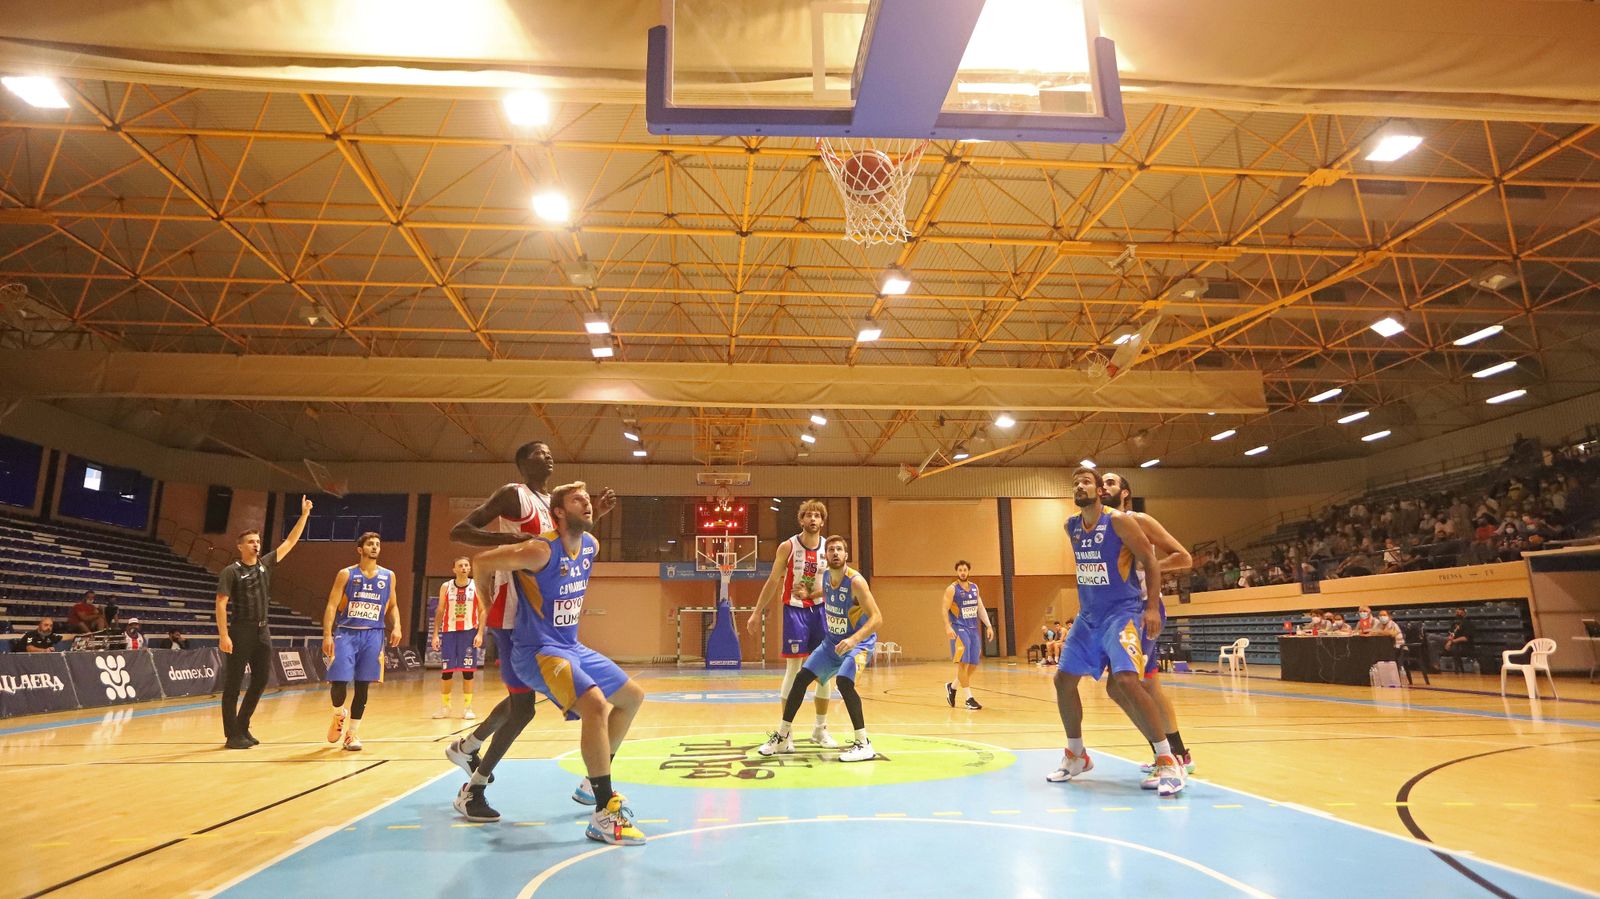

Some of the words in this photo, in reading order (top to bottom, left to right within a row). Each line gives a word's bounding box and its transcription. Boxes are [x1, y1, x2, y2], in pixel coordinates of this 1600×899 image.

[1081, 539, 1092, 547] 12
[570, 566, 581, 577] 41
[831, 594, 835, 602] 6
[351, 601, 380, 611] TOYOTA
[555, 597, 583, 611] TOYO
[349, 610, 378, 619] CUMACA
[1119, 630, 1137, 644] 12
[463, 658, 473, 666] 30
[168, 665, 215, 681] damex.io
